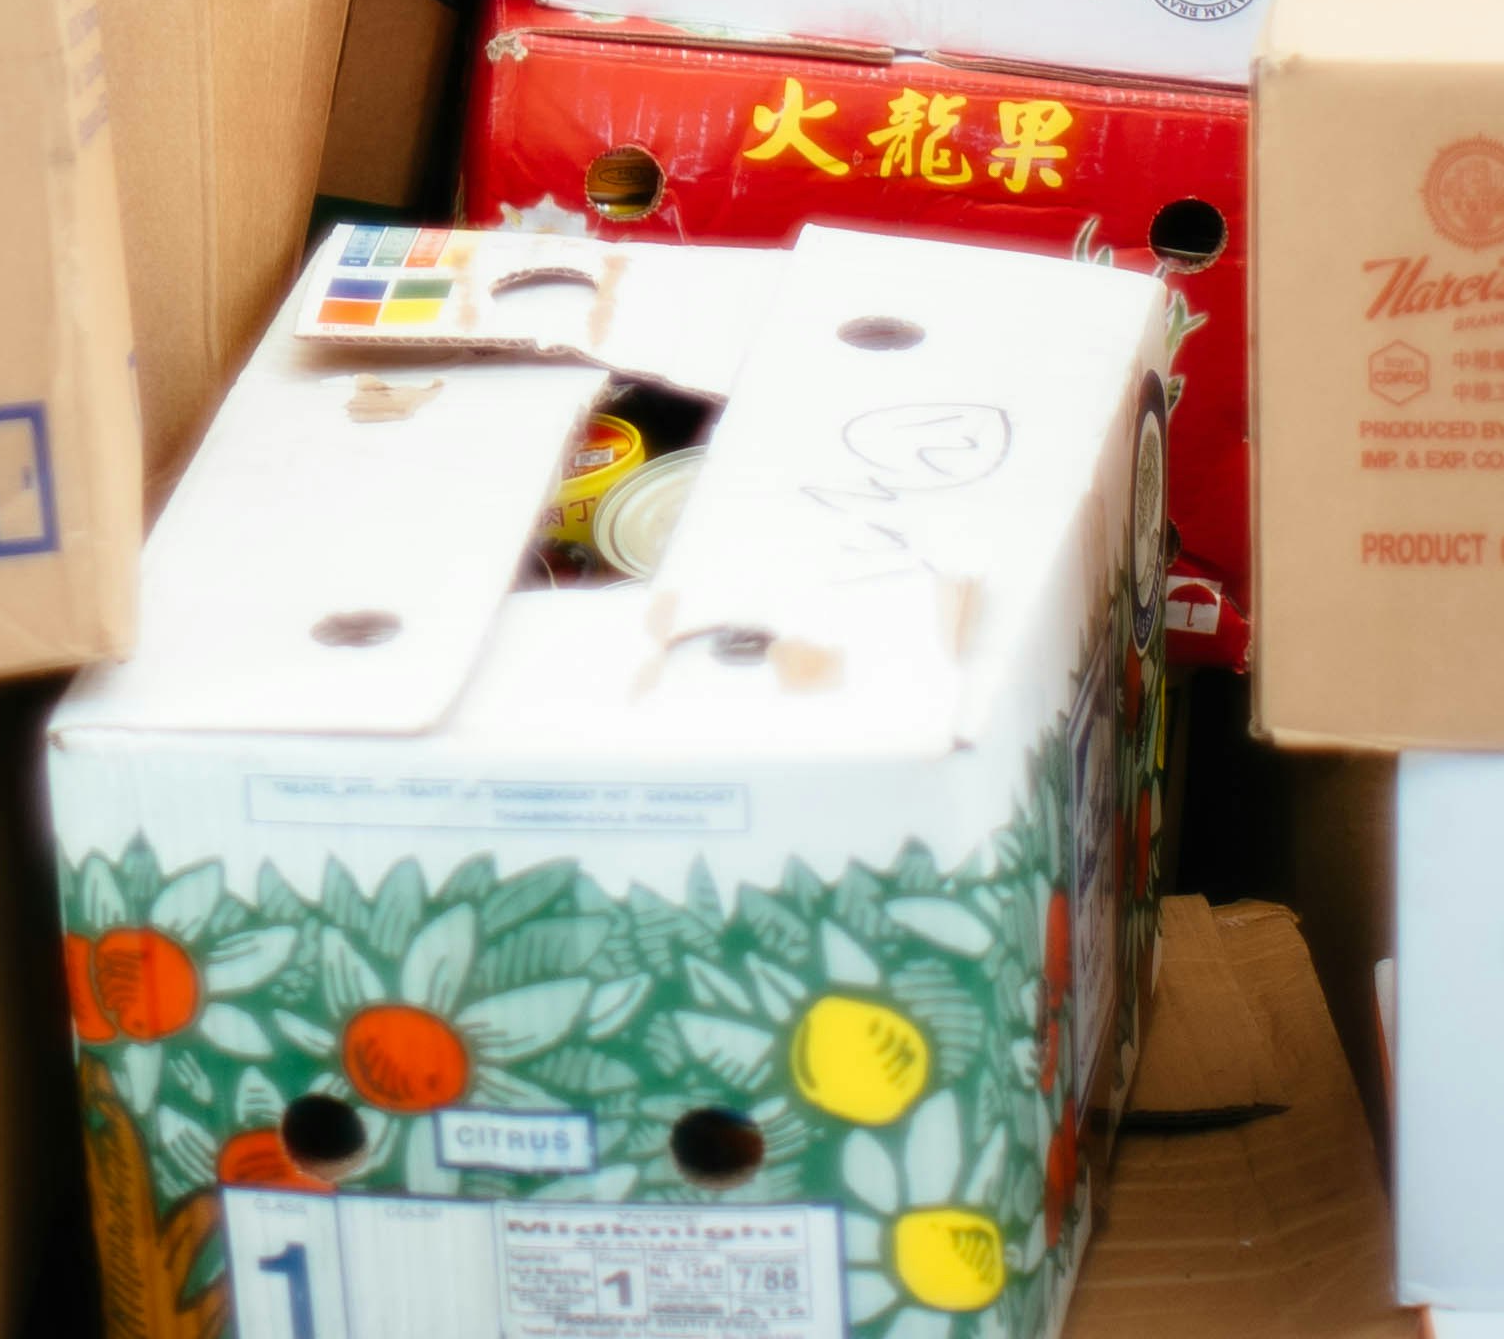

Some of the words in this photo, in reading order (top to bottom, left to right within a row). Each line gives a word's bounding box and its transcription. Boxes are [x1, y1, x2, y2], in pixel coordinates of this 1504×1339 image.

[740, 74, 1077, 197] 火龍果
[1360, 533, 1485, 567] PRODUCT
[454, 1119, 572, 1157] CITRUS
